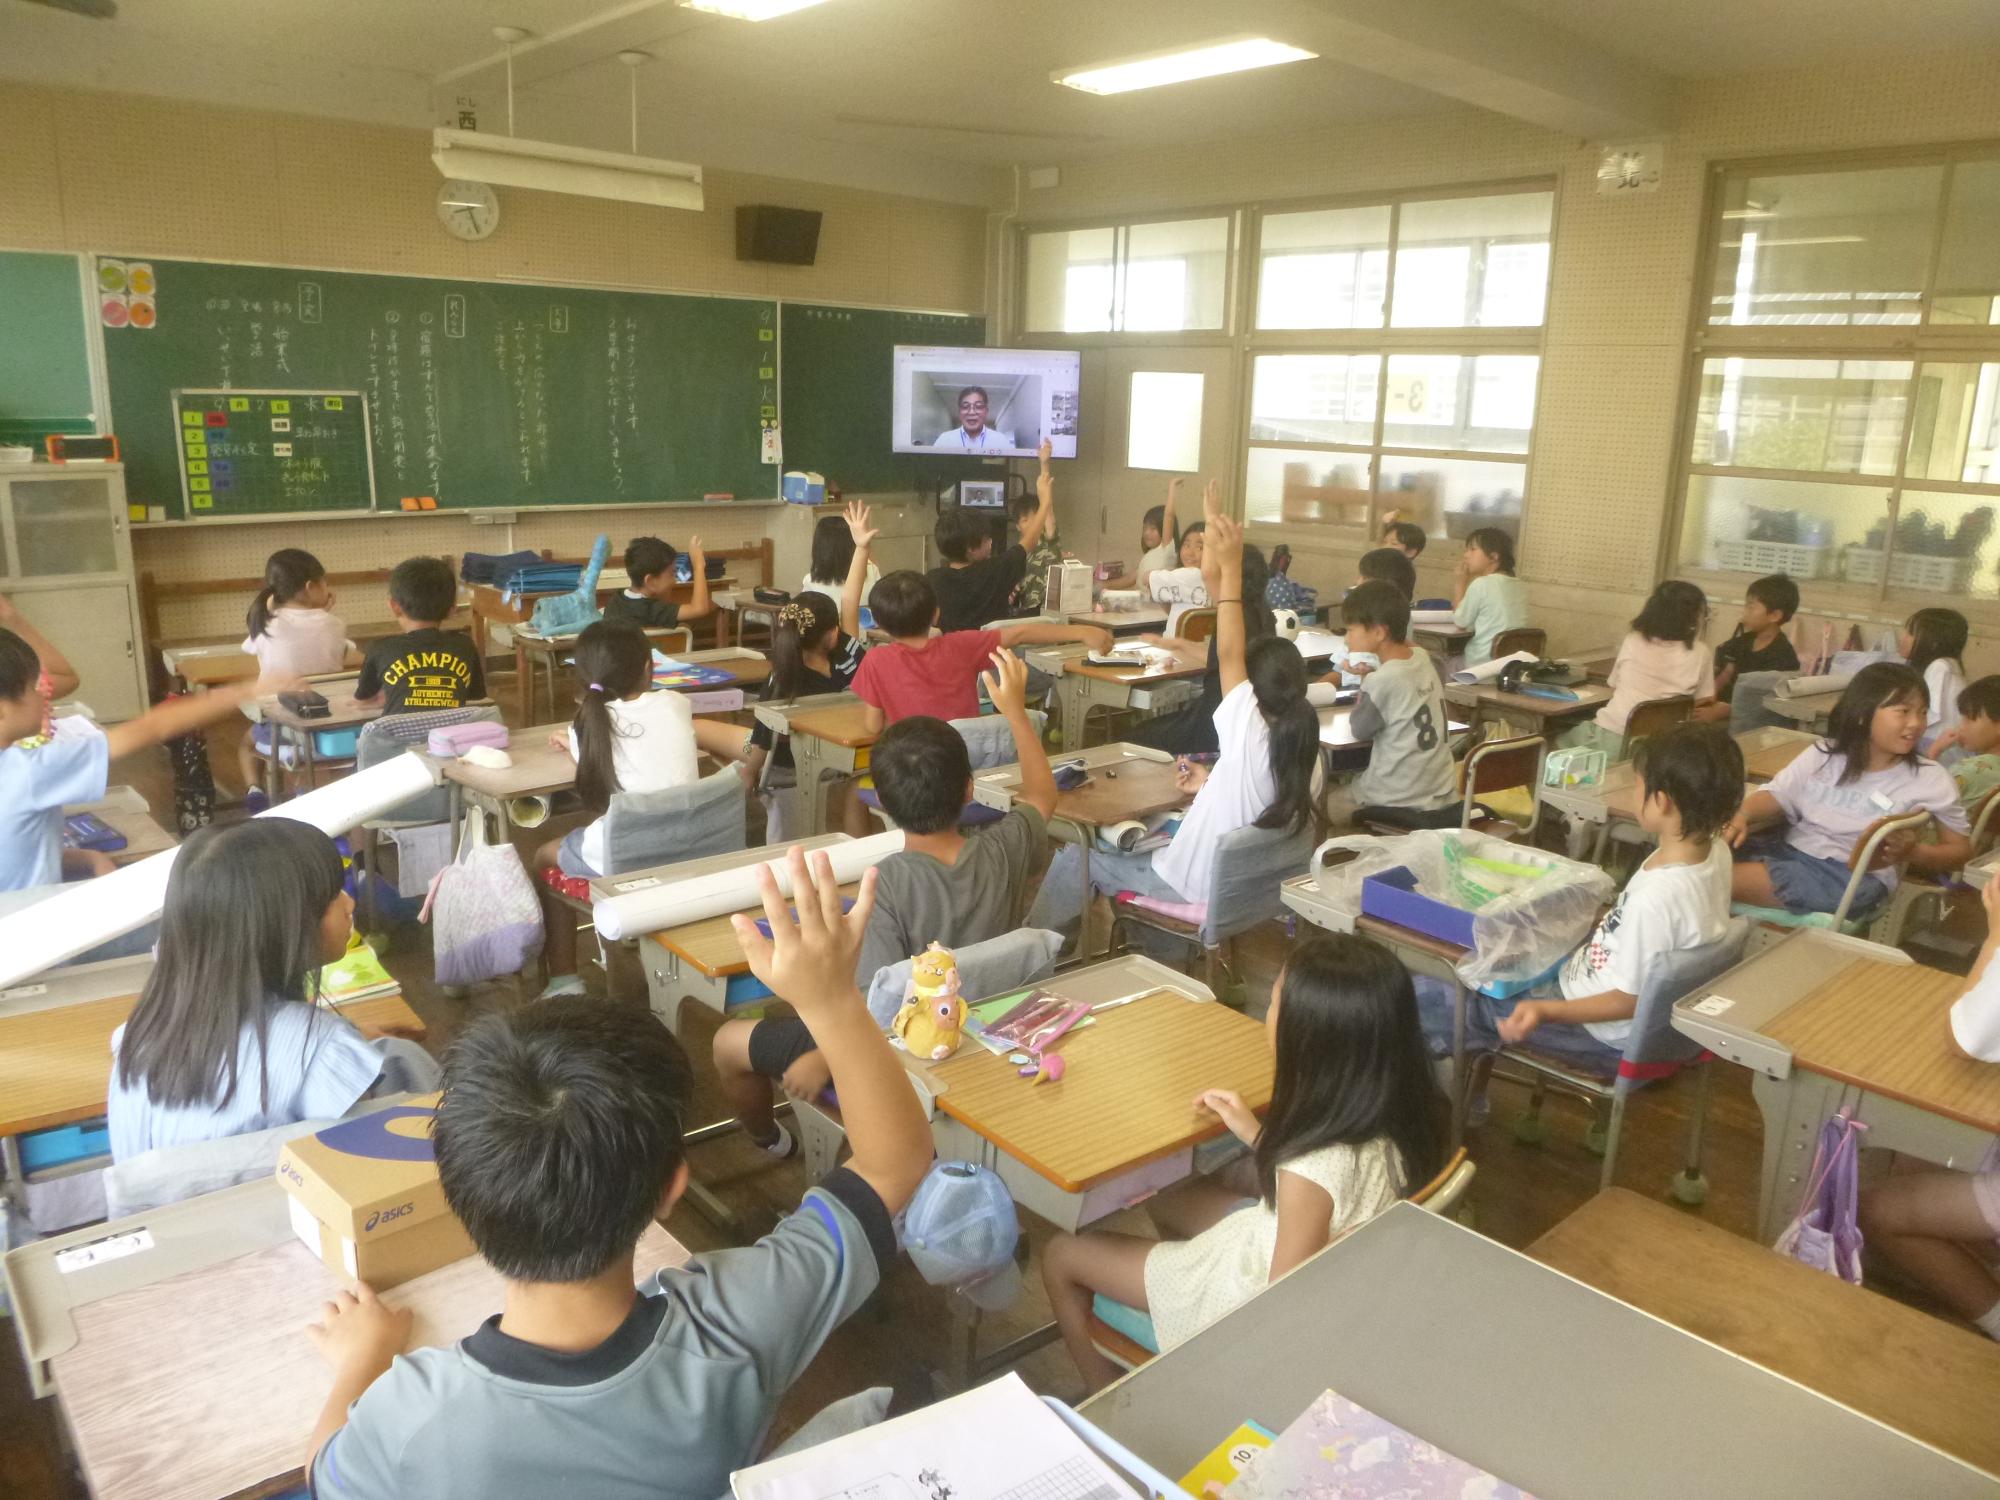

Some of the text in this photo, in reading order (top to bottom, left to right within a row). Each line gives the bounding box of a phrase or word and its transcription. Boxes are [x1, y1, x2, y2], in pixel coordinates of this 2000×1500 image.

[458, 111, 477, 132] 西
[303, 397, 320, 412] 水
[384, 652, 472, 688] CHAMPION
[411, 689, 454, 699] AUTHENTIC
[1233, 1449, 1252, 1464] 10
